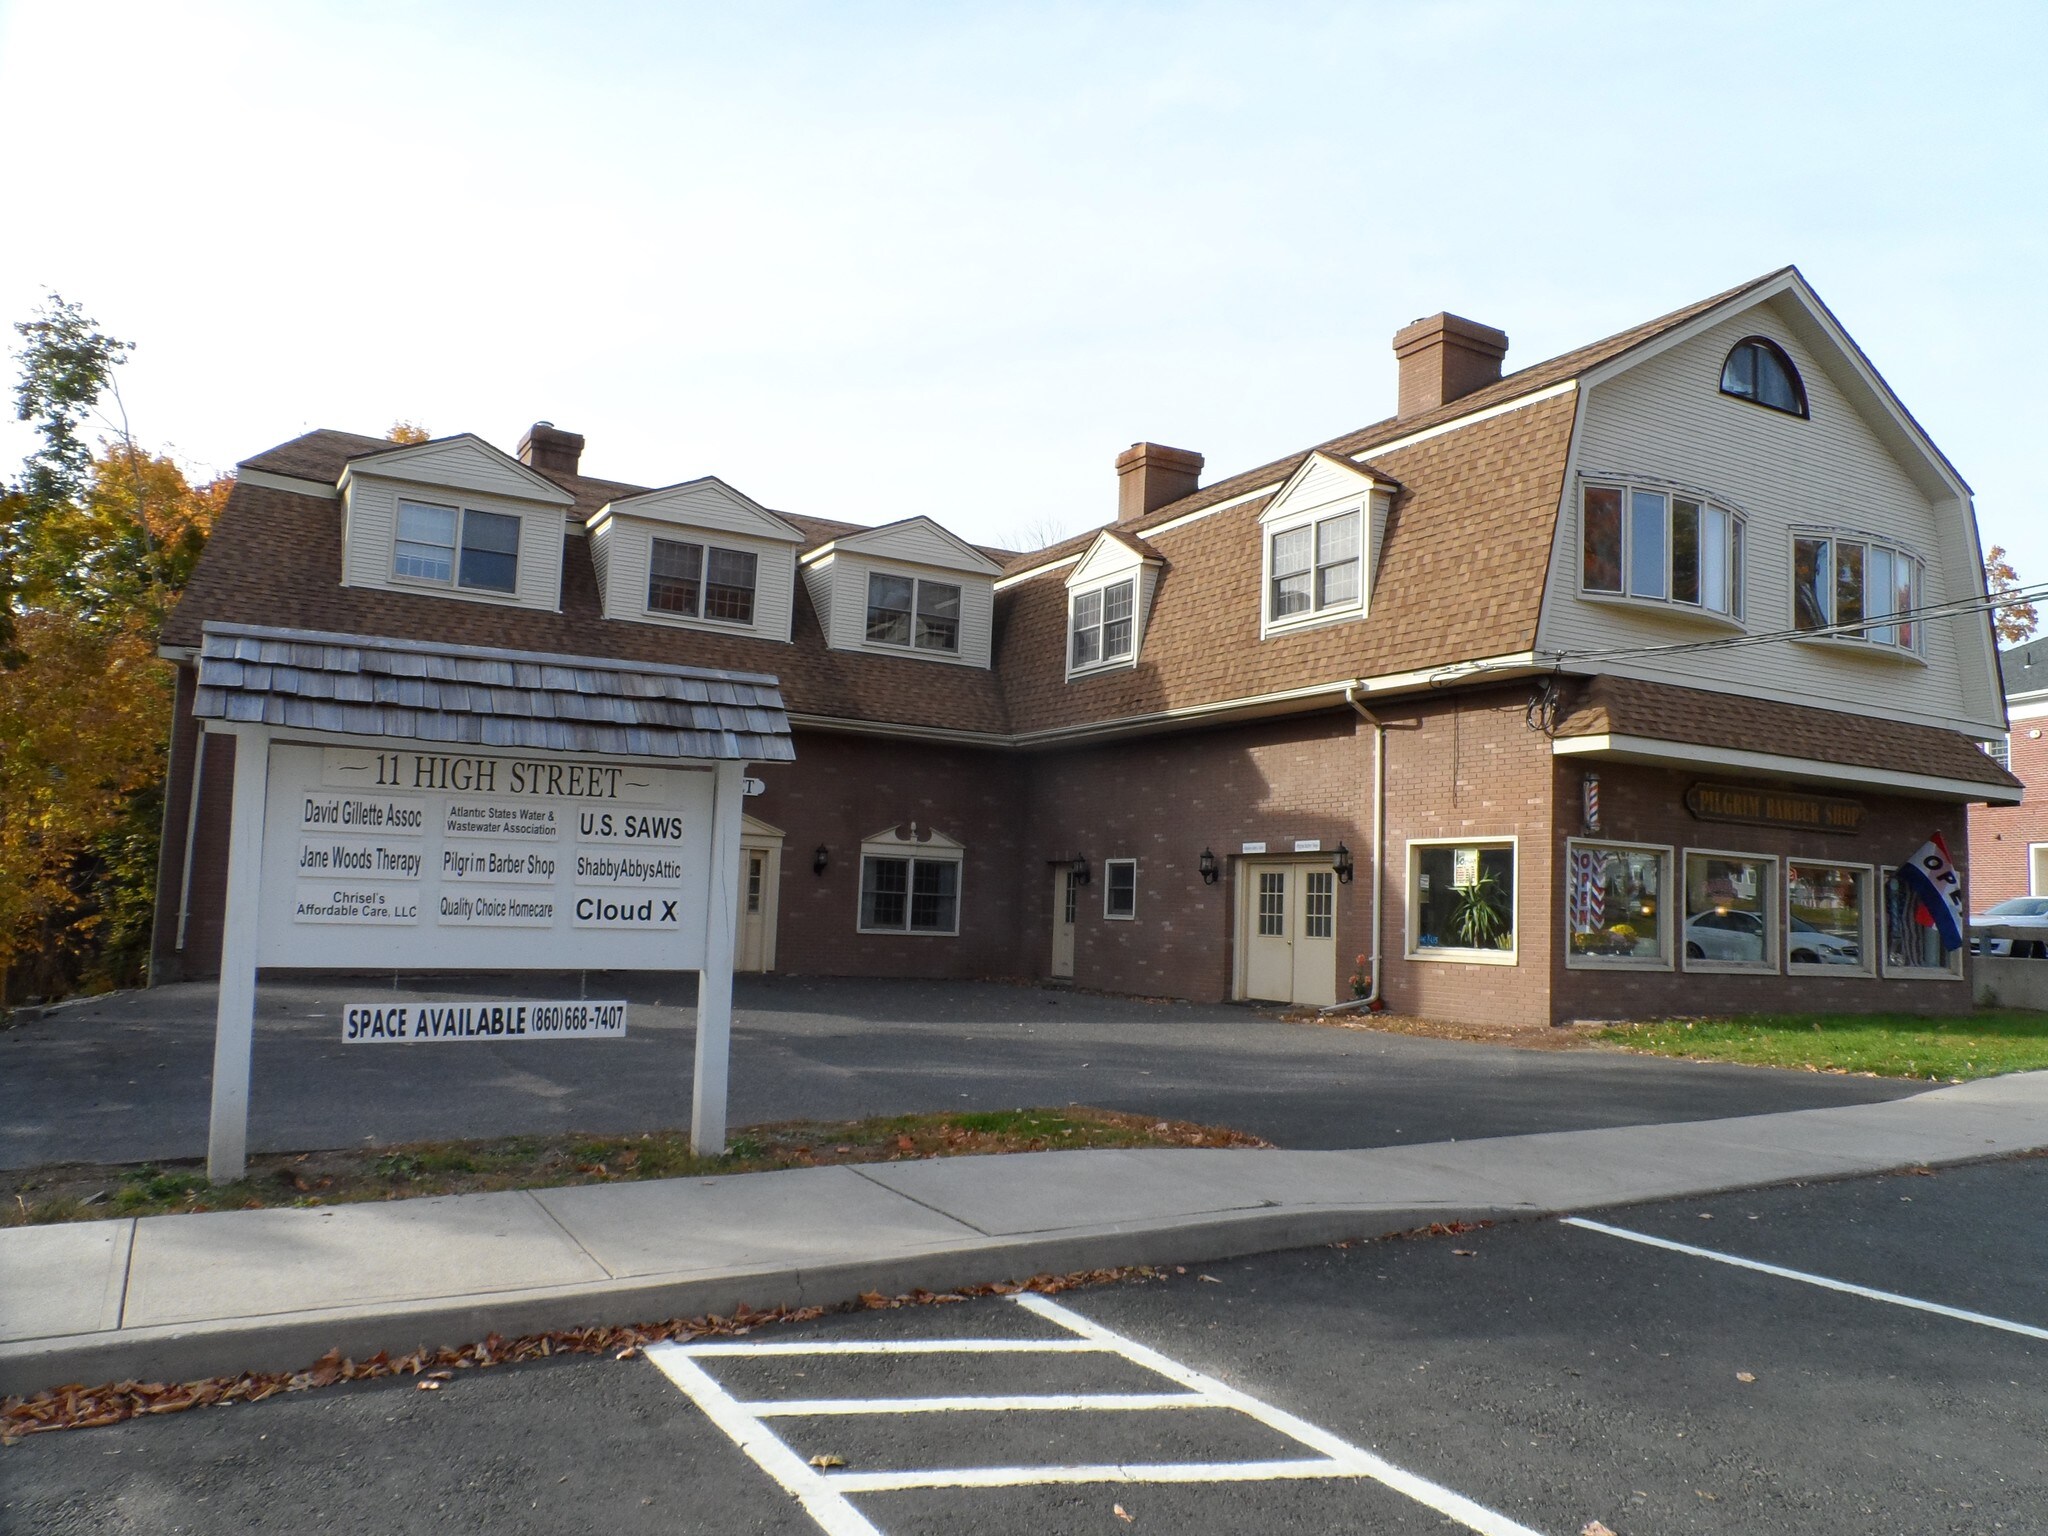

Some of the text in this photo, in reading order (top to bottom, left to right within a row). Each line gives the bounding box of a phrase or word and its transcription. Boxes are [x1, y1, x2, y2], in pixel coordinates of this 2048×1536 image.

[376, 753, 623, 798] 11 HIGH STREET
[304, 799, 422, 827] David Gillette Assoc
[450, 806, 555, 822] Atlantic States Water &
[1700, 790, 1760, 817] PILGRIM
[447, 820, 557, 836] Wastewater Association
[580, 813, 683, 840] U.S. SAWS
[300, 845, 421, 877] Jane Woods Therapy
[443, 851, 555, 879] Pilgrim Barber Shop
[577, 856, 681, 882] ShabbyAbbysAttic
[296, 903, 358, 916] Affordable
[394, 906, 417, 917] LLC
[333, 891, 386, 905] Chrisel's
[441, 896, 553, 920] Quality Choice Homecare
[576, 898, 678, 922] Cloud X
[348, 1005, 624, 1039] SPACE AVAILABLE (860)668-7407
